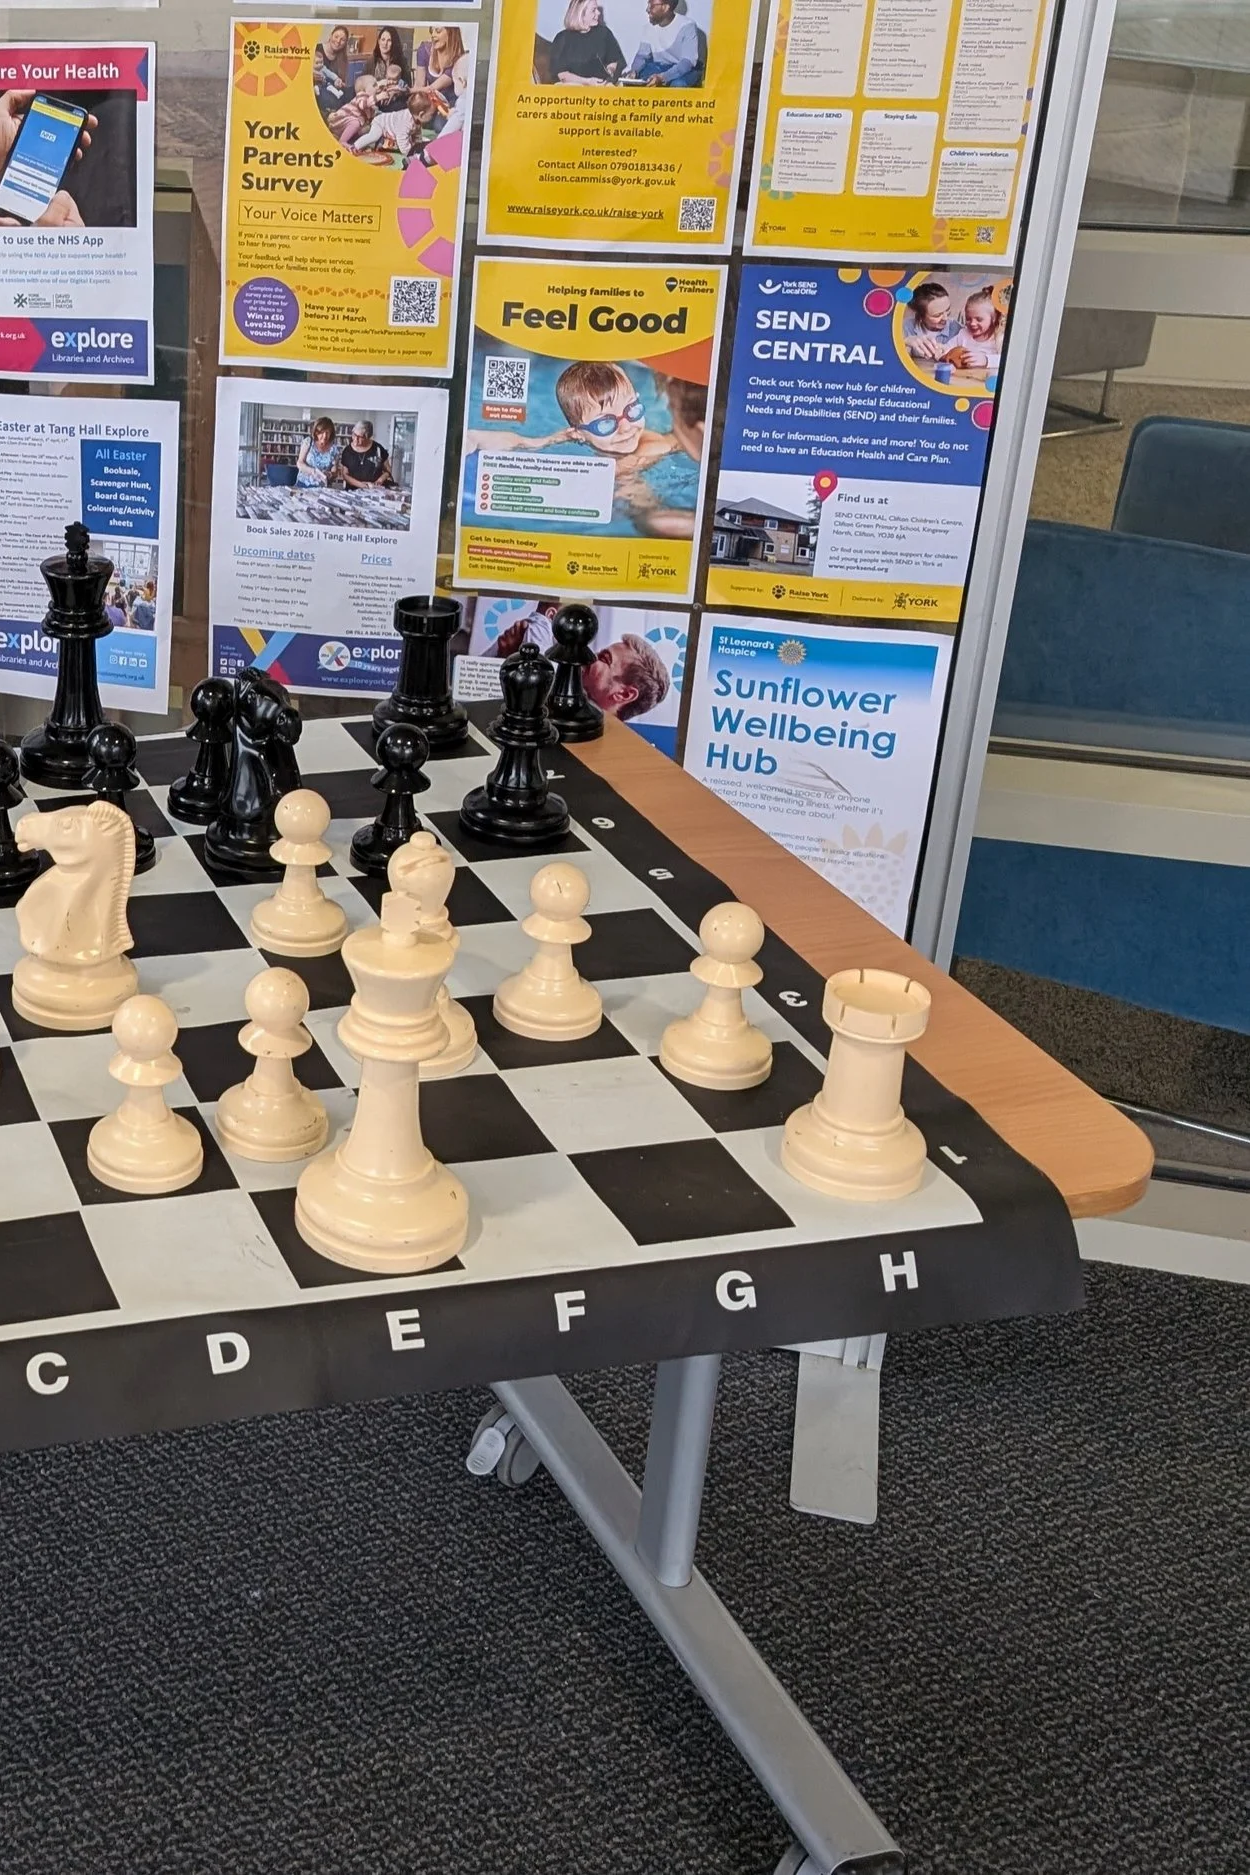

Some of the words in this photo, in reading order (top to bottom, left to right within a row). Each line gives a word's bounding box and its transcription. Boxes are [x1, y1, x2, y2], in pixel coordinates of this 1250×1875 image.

[264, 45, 288, 55] Raise
[289, 46, 310, 55] York
[21, 64, 59, 78] Your
[65, 62, 119, 78] Health
[244, 120, 300, 140] York
[581, 148, 637, 156] Interested?
[537, 160, 576, 169] Contact
[578, 161, 608, 169] Alison
[610, 162, 675, 172] 07901813436
[676, 163, 682, 173] /
[241, 172, 323, 198] Survey
[538, 173, 675, 186] alison.cammiss@york.gov.uk
[243, 205, 276, 219] Your
[281, 207, 317, 221] Voice
[322, 209, 373, 224] Matters
[507, 203, 665, 220] www.raiseyork.co.uk/raise-york
[2, 235, 13, 244] to
[37, 235, 55, 244] the
[57, 235, 79, 244] NHS
[82, 235, 103, 247] App
[678, 285, 714, 293] Trainers
[679, 278, 707, 287] Health
[782, 280, 797, 288] York
[798, 281, 818, 289] SEND
[547, 285, 587, 297] Helping
[589, 286, 631, 297] families
[633, 289, 644, 297] to
[245, 312, 263, 322] Win
[264, 314, 269, 322] a
[270, 313, 284, 321] £50
[501, 301, 578, 330] Feel
[588, 306, 688, 333] Good
[755, 310, 830, 331] SEND
[51, 329, 133, 351] explore
[752, 340, 883, 364] CENTRAL
[33, 423, 45, 433] at
[47, 423, 75, 437] Tang
[79, 424, 101, 435] Hall
[105, 425, 149, 438] Explore
[95, 448, 110, 459] All
[113, 449, 147, 460] Easter
[103, 466, 140, 476] Booksale,
[90, 478, 129, 488] Scavenger
[130, 480, 151, 490] Hunt,
[94, 491, 117, 499] Board
[119, 492, 147, 503] Games,
[837, 493, 860, 502] Find
[86, 504, 155, 516] Colouring/Activity
[109, 518, 133, 527] sheets
[246, 525, 267, 533] Book
[269, 526, 291, 536] Sales
[293, 528, 314, 537] 2026
[316, 530, 319, 540] |
[322, 531, 343, 542] Tang
[345, 533, 362, 541] Hall
[364, 534, 397, 544] Explore
[233, 545, 285, 560] Upcoming
[287, 548, 316, 561] dates
[361, 553, 392, 566] Prices
[719, 636, 728, 646] St
[729, 637, 774, 649] Leonard's
[352, 645, 402, 661] explor
[717, 645, 756, 656] Hospice
[714, 670, 897, 714] Sunflower
[712, 706, 896, 758] Wellbeing
[706, 742, 778, 775] Hub
[880, 1251, 918, 1292] H
[716, 1271, 756, 1311] G
[554, 1290, 585, 1332] F
[386, 1309, 425, 1350] E
[207, 1332, 250, 1374] D
[27, 1352, 69, 1394] C
